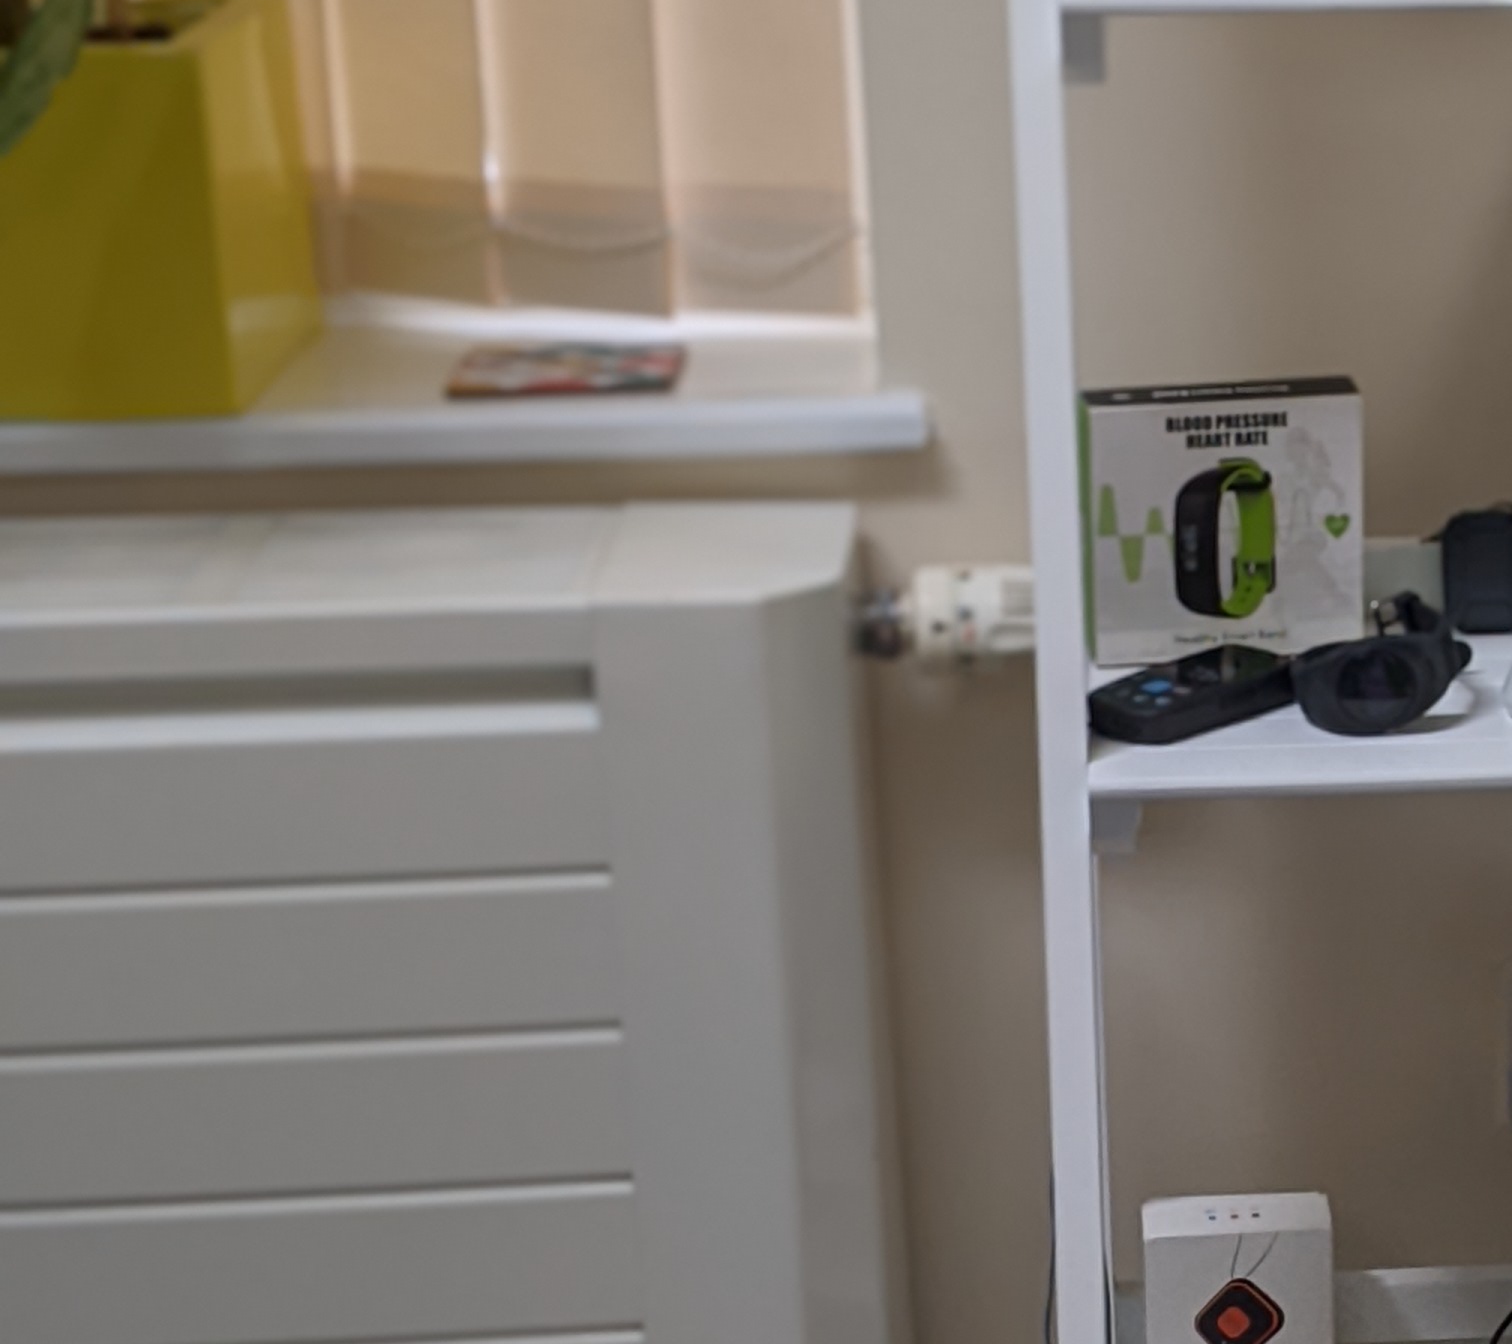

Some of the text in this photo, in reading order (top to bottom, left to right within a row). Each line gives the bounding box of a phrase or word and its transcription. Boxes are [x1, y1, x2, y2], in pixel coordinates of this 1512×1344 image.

[1165, 411, 1288, 432] BLOOD PRESSURE
[1186, 430, 1268, 449] HEART RATE
